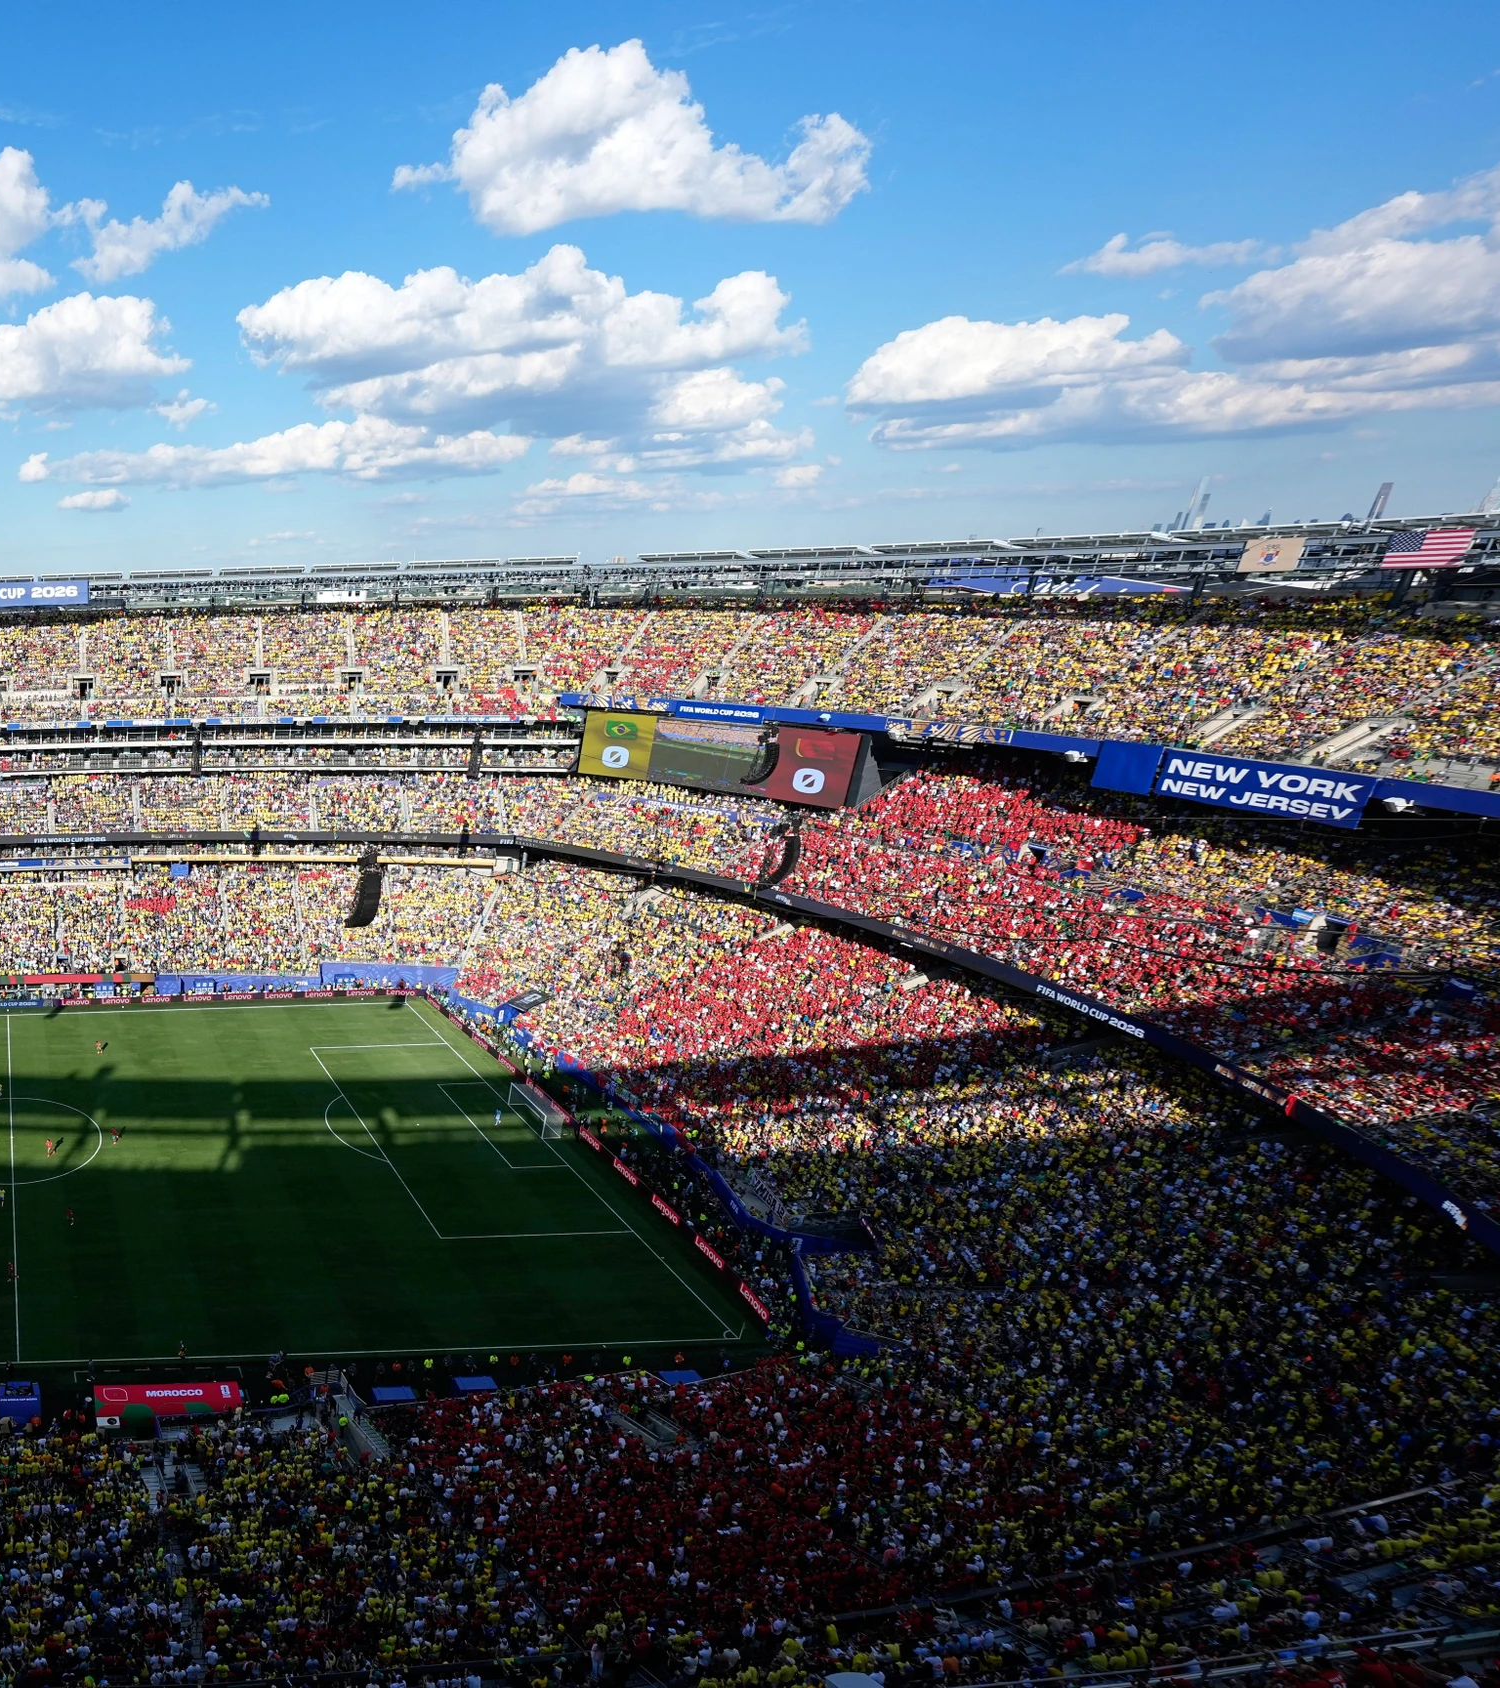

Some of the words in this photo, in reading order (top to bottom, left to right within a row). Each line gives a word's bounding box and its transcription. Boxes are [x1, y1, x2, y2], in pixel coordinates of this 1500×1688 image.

[31, 586, 78, 599] 2026
[695, 707, 718, 715] WORLD
[734, 710, 759, 719] 2026
[1167, 758, 1250, 784] NEW
[1257, 770, 1364, 802] YORK
[1161, 779, 1227, 800] NEW
[1229, 791, 1354, 820] JERSEY
[61, 998, 89, 1006] Lenovo
[305, 990, 333, 998] Lenovo
[1036, 984, 1056, 999] FIFA
[1056, 992, 1089, 1013] WORLD
[1088, 1008, 1109, 1021] CUP
[1108, 1016, 1146, 1039] 2026
[472, 1031, 488, 1050] Lenovo
[498, 1055, 515, 1074] Lenovo
[526, 1078, 544, 1098] Leovo
[551, 1100, 570, 1122] Lenovo
[613, 1157, 637, 1185] Lenovo
[651, 1194, 679, 1224] Lenovo
[730, 1200, 739, 1214] FIFA
[695, 1235, 723, 1269] Lenovo
[739, 1282, 767, 1321] Lenovo
[145, 1389, 203, 1397] MOROCCO
